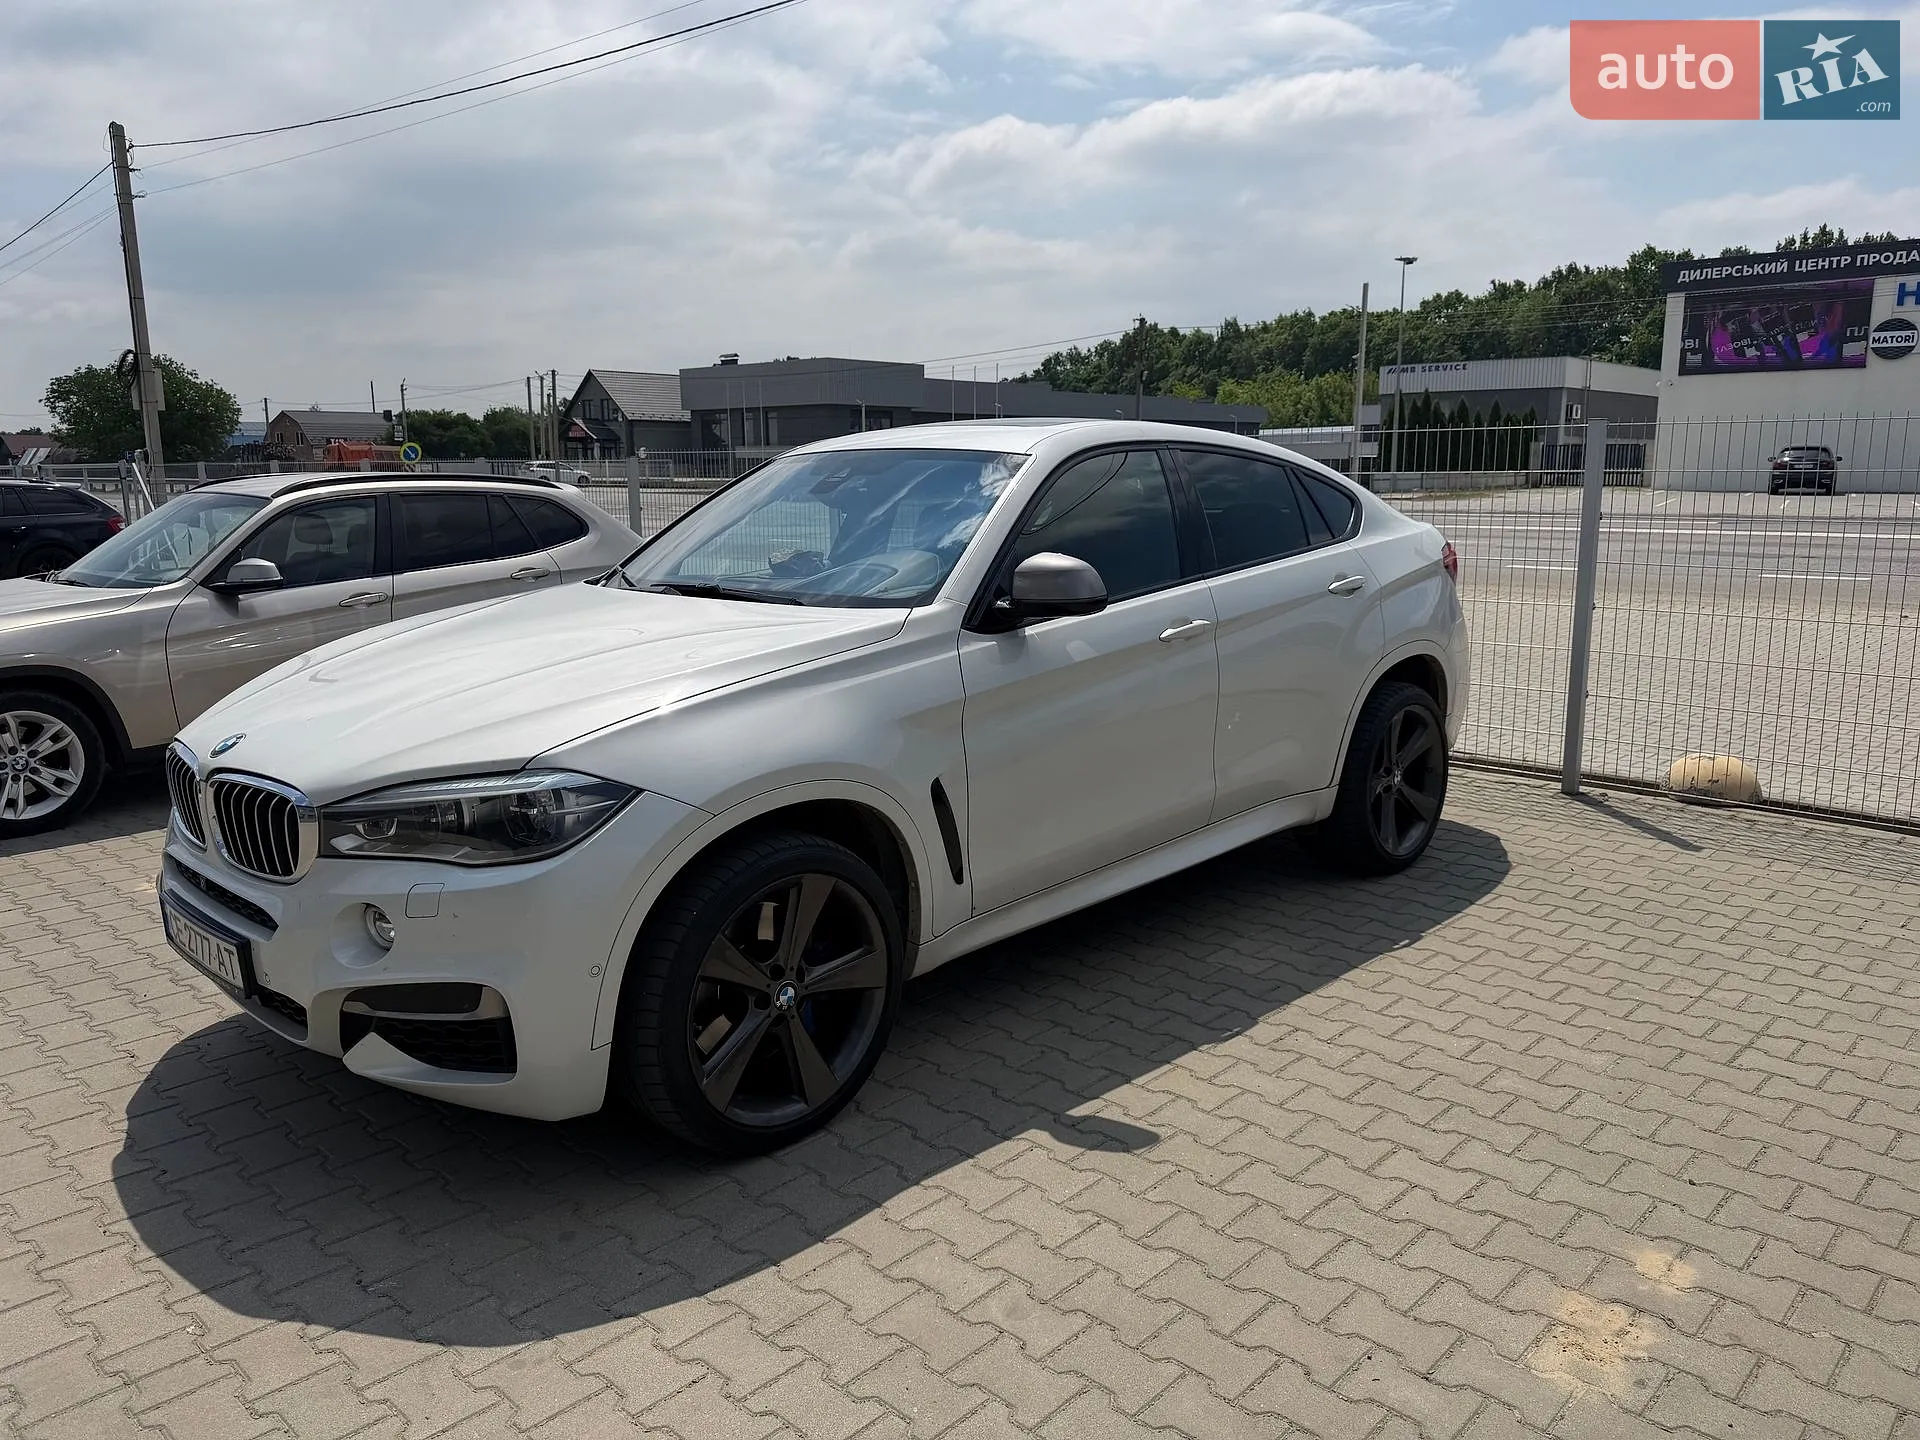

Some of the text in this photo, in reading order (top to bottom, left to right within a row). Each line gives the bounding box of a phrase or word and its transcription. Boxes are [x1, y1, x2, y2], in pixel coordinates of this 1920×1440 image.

[1677, 249, 1920, 283] ДИЛЕРСЬКИЙ ЦЕНТР ПРОДА
[1421, 363, 1467, 373] SERVICE
[216, 942, 235, 980] AT
